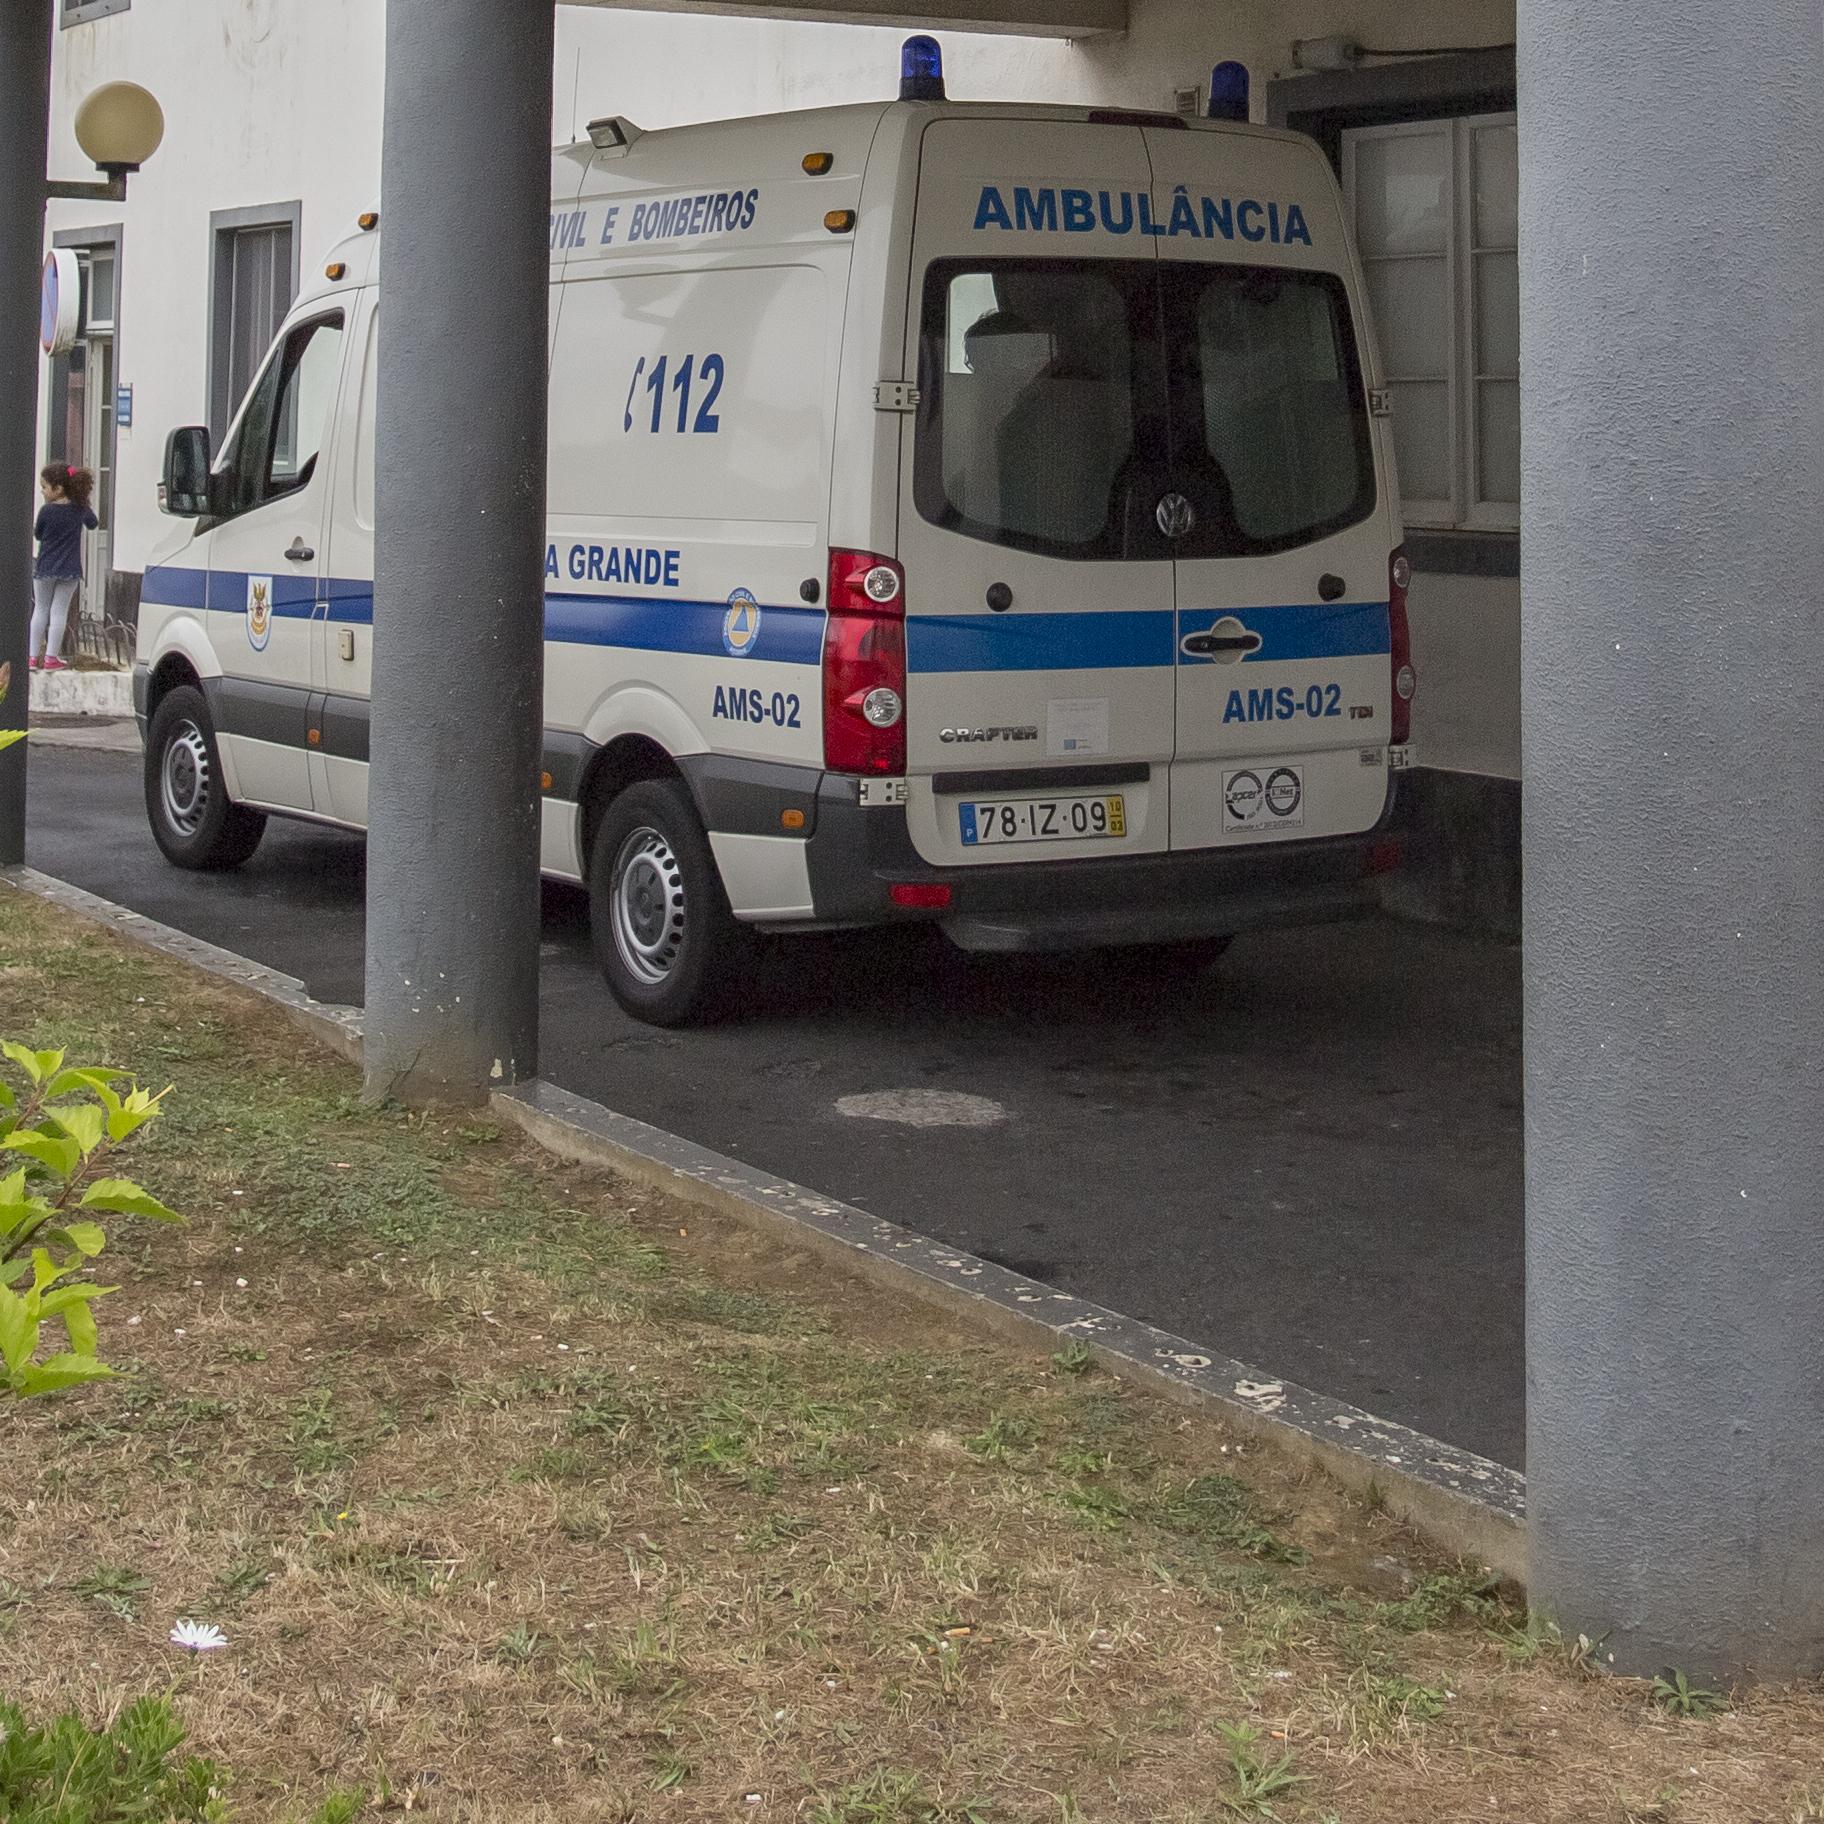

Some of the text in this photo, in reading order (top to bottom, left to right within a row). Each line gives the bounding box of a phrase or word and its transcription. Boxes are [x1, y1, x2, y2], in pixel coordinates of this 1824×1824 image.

[600, 207, 619, 245] E
[628, 188, 759, 242] BOMBEIROS
[973, 185, 1313, 247] AMBULÂNCIA
[646, 353, 724, 433] 112
[568, 544, 680, 587] GRANDE
[712, 685, 801, 728] AMS-02
[1223, 683, 1341, 724] AMS-02
